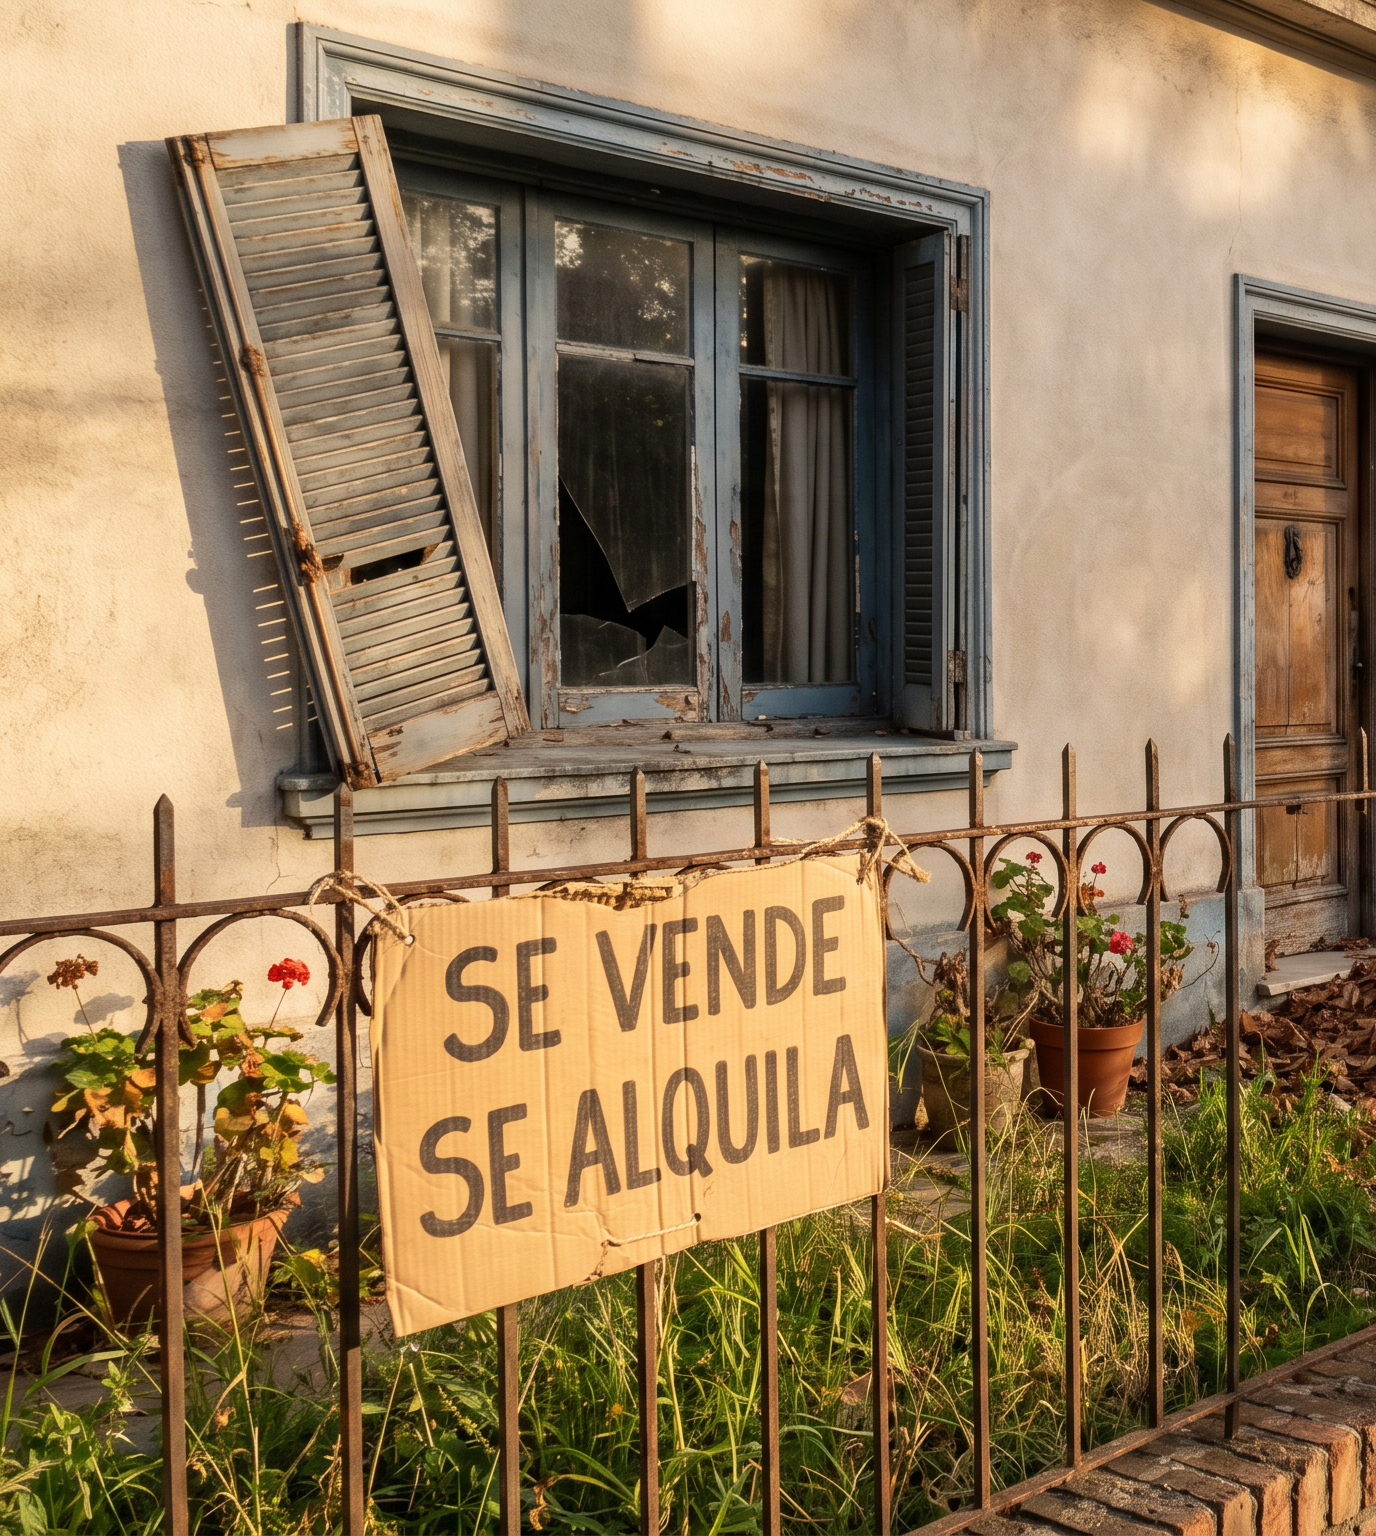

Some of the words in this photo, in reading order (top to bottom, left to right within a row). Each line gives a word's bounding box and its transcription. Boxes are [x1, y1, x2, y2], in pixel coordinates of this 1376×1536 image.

[443, 936, 562, 1063] SE
[595, 894, 847, 1033] VENDE
[418, 1103, 534, 1239] SE
[563, 1033, 871, 1208] ALQUILA
